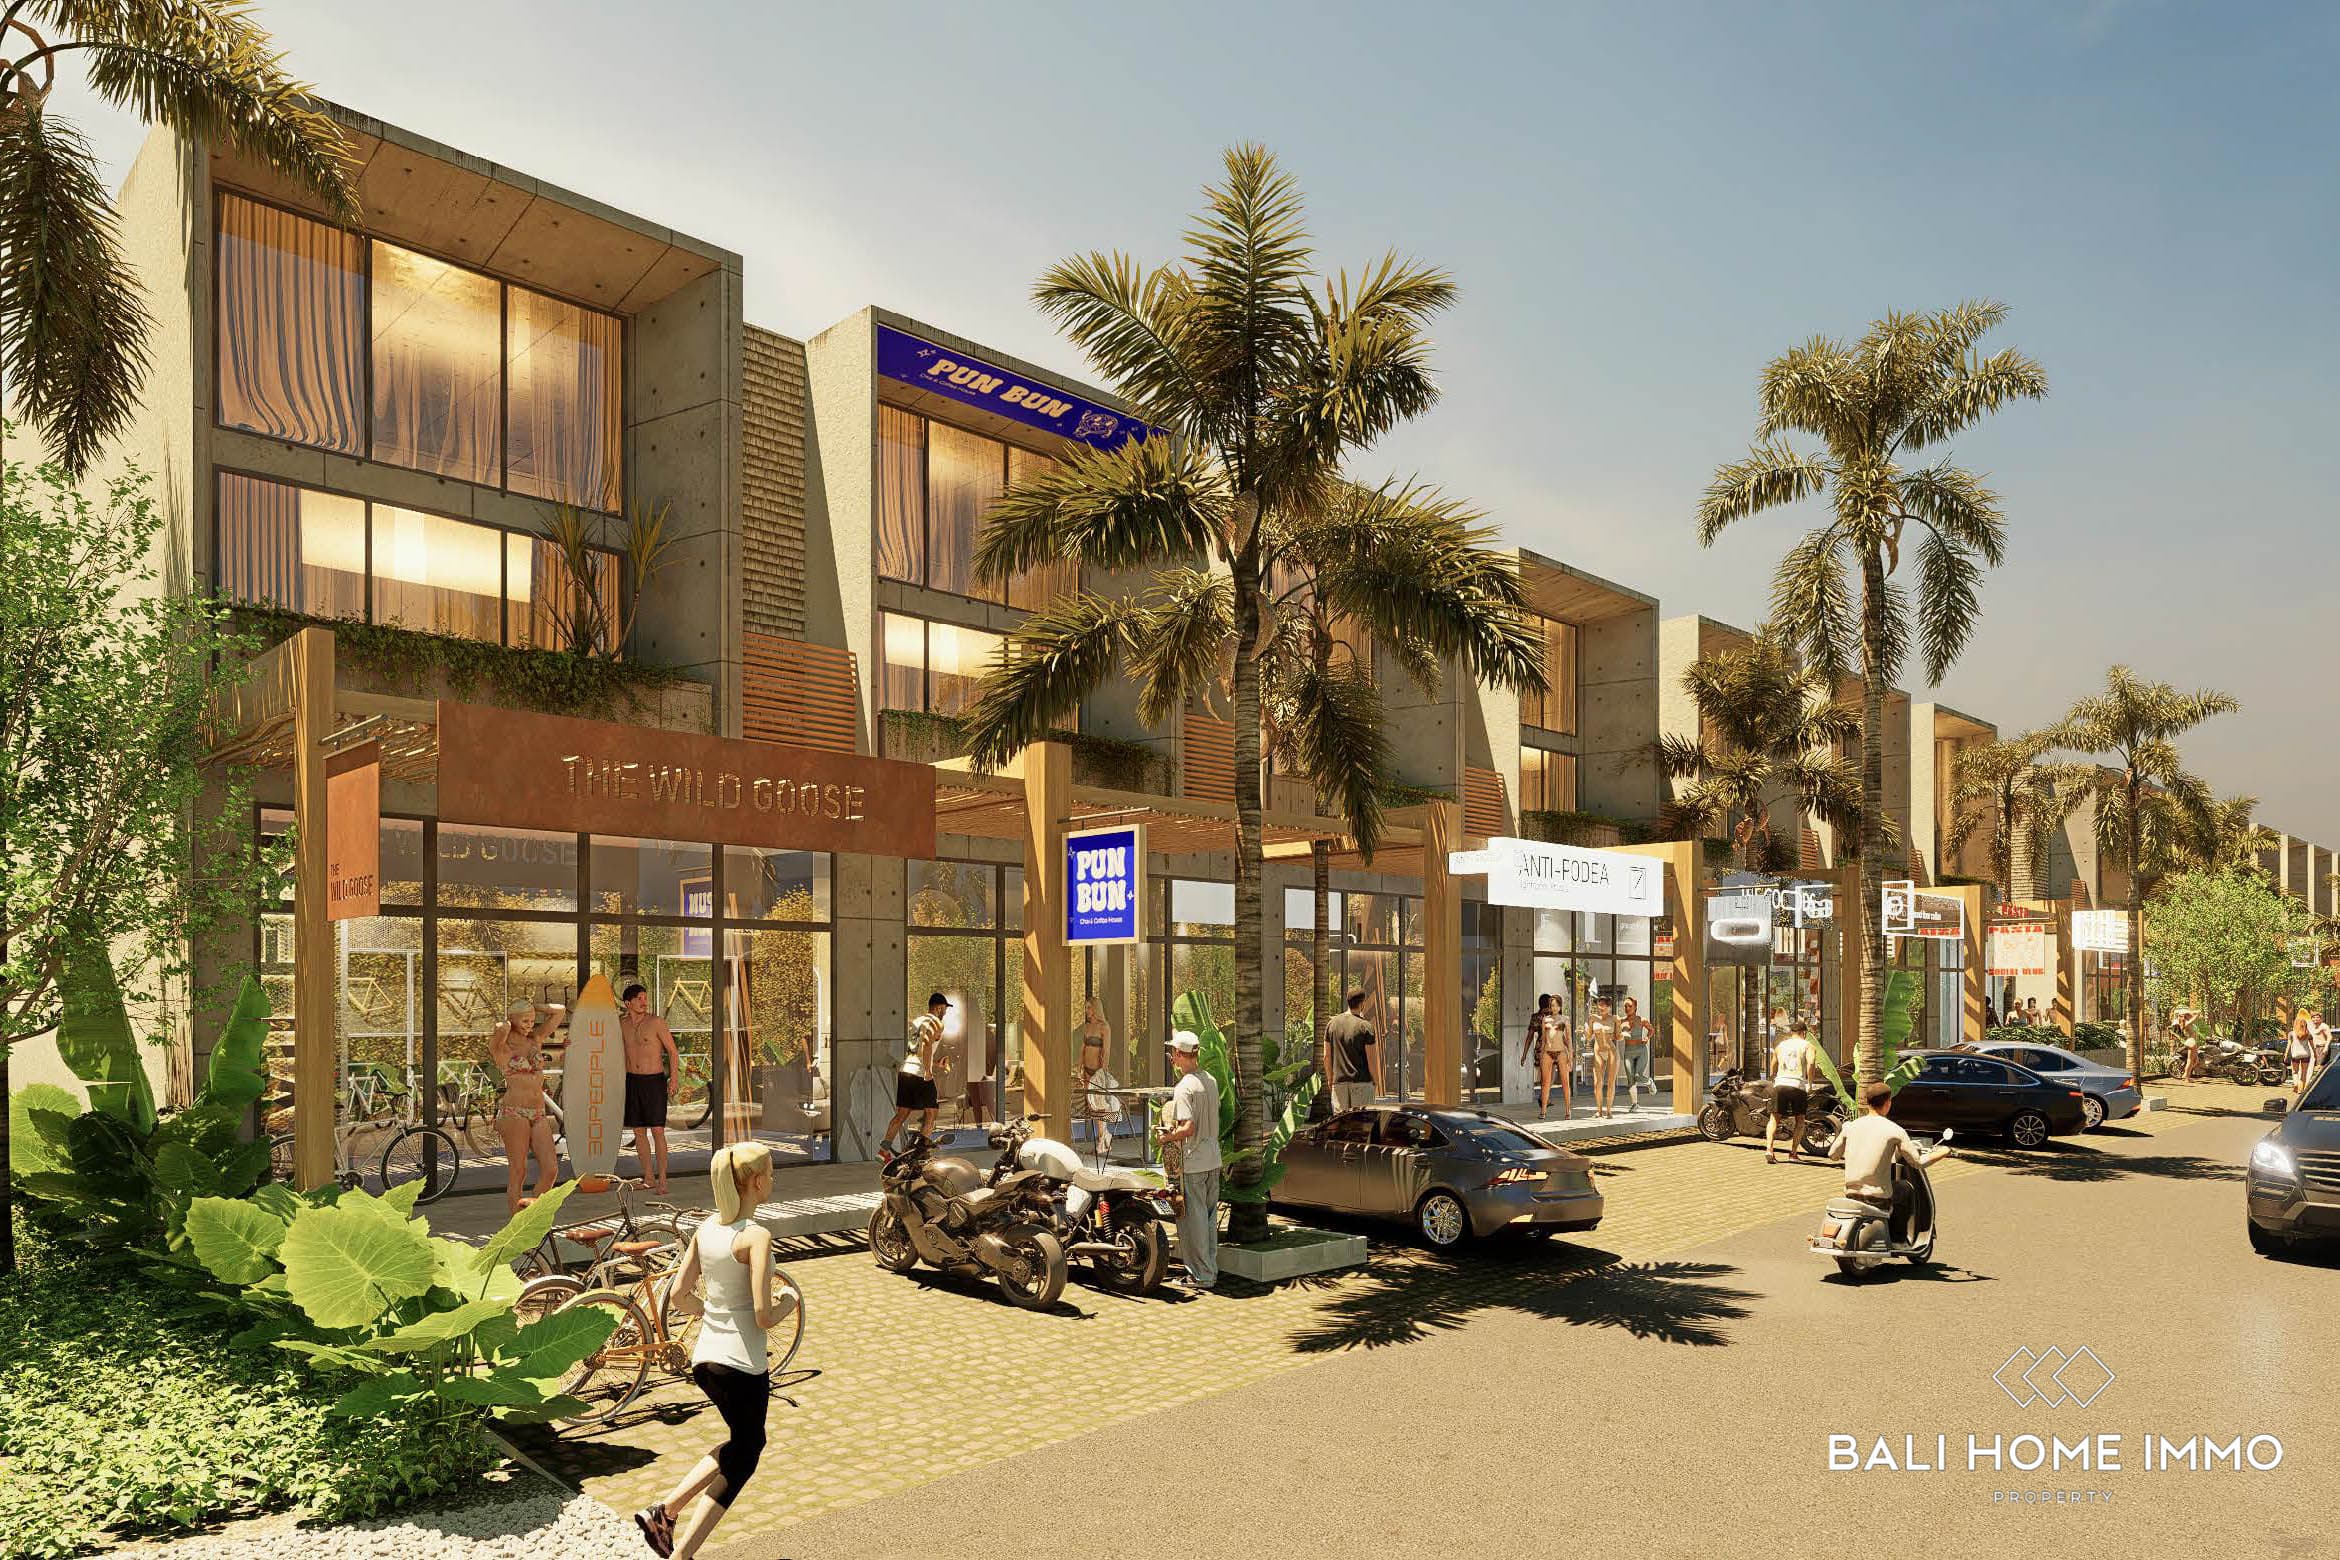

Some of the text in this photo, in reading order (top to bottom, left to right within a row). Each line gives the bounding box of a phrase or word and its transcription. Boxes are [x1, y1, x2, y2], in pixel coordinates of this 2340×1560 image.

[927, 359, 1073, 418] PUN BUN
[561, 754, 865, 821] THE WILD GOOSE
[1076, 847, 1126, 881] PUN
[1518, 853, 1610, 888] ANTI-FODEA
[330, 874, 374, 902] WILD GOOSE
[1076, 880, 1127, 913] BUN
